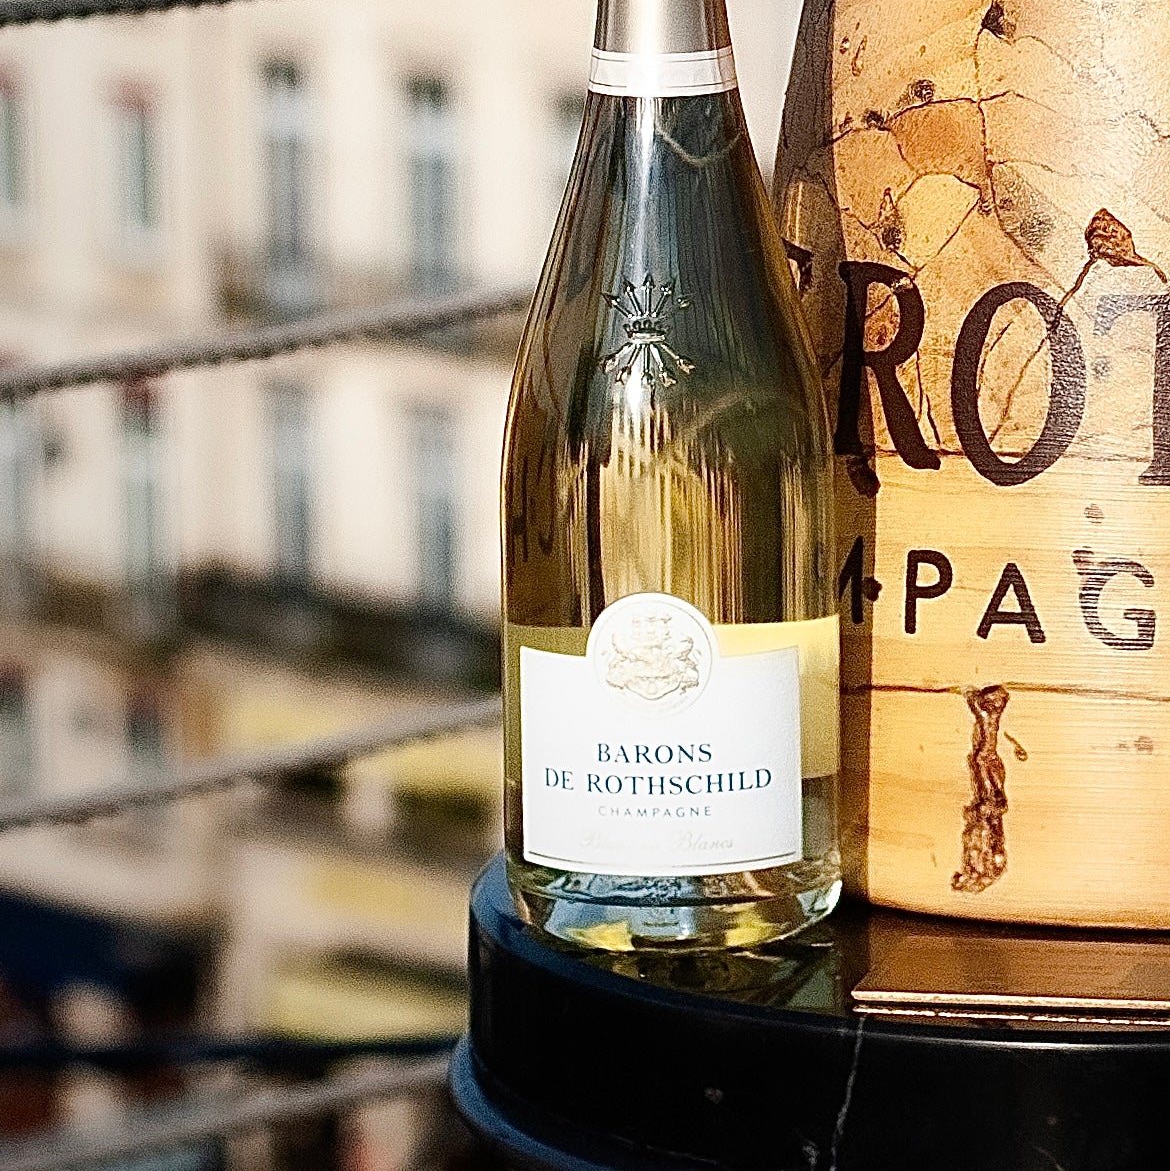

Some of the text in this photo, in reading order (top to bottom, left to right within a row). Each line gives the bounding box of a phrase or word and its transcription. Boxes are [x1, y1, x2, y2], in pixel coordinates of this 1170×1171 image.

[597, 742, 713, 765] BARONS
[544, 767, 773, 796] DE ROTHSCHILD
[597, 804, 713, 818] CHAMPAGNE
